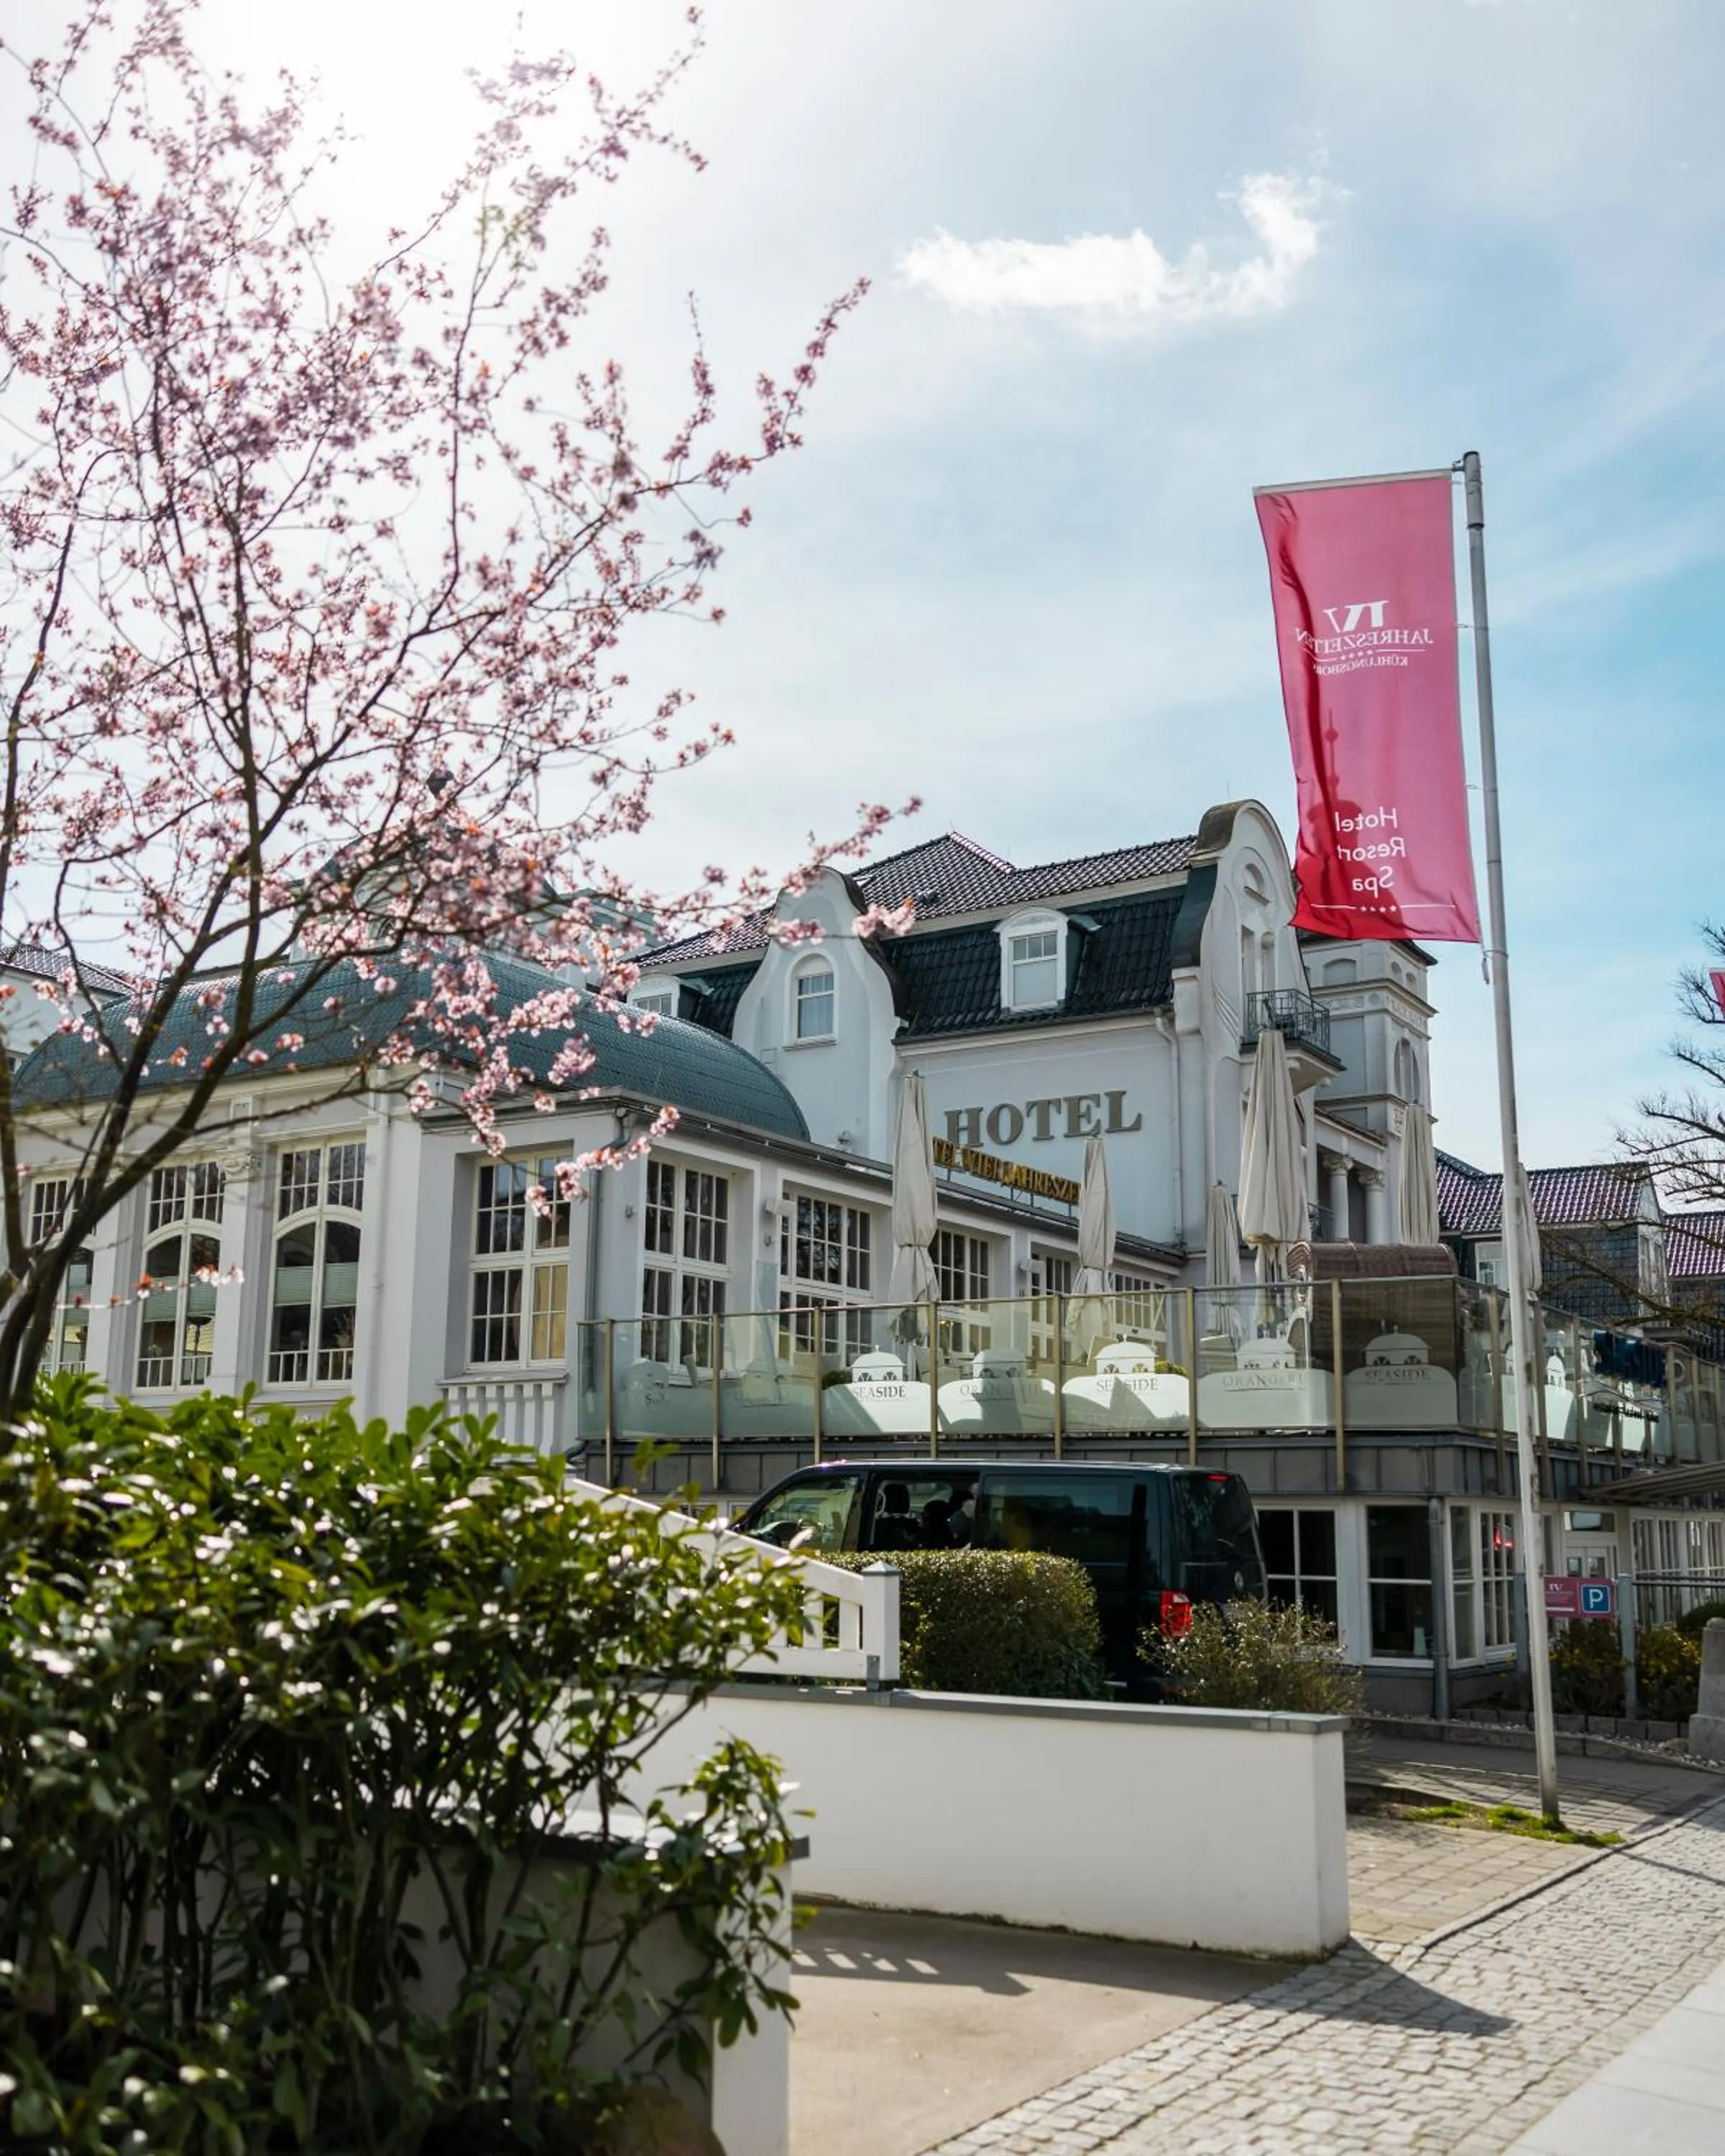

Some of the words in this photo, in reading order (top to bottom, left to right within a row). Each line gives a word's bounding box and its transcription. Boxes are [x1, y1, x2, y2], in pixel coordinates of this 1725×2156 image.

[944, 1090, 1142, 1148] HOTEL
[1004, 1161, 1081, 1204] JAHRESZE
[1588, 1588, 1604, 1609] P
